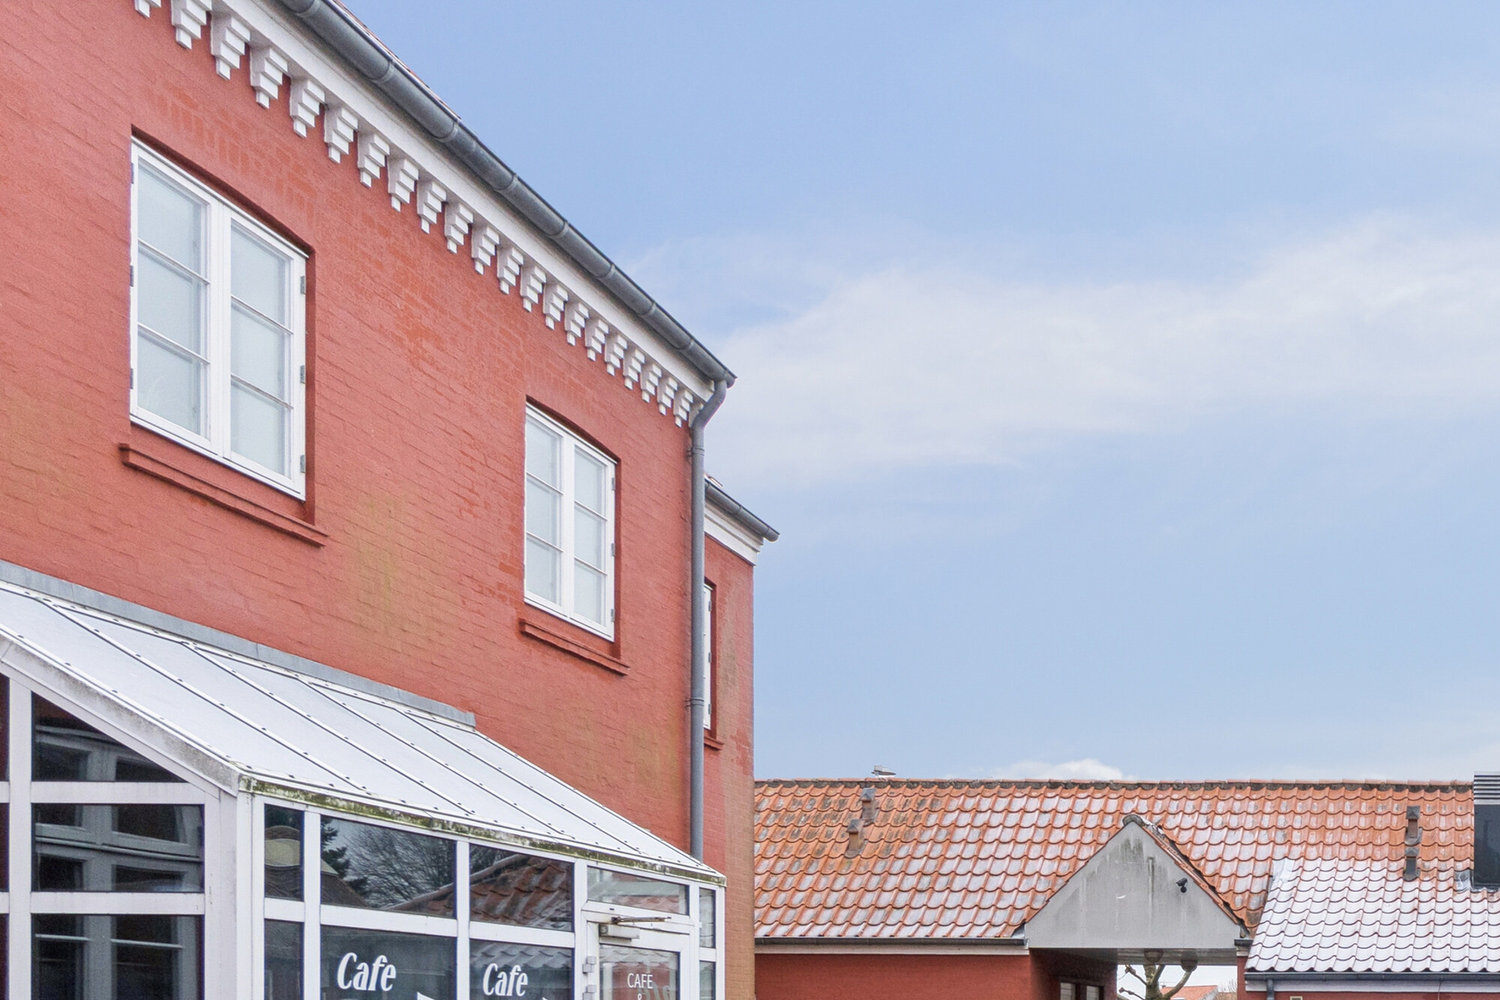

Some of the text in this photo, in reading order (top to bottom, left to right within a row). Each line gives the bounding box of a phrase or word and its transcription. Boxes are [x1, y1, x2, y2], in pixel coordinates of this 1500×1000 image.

[337, 952, 397, 992] Cafe
[482, 963, 529, 997] Cafe
[627, 972, 653, 989] CAFE
